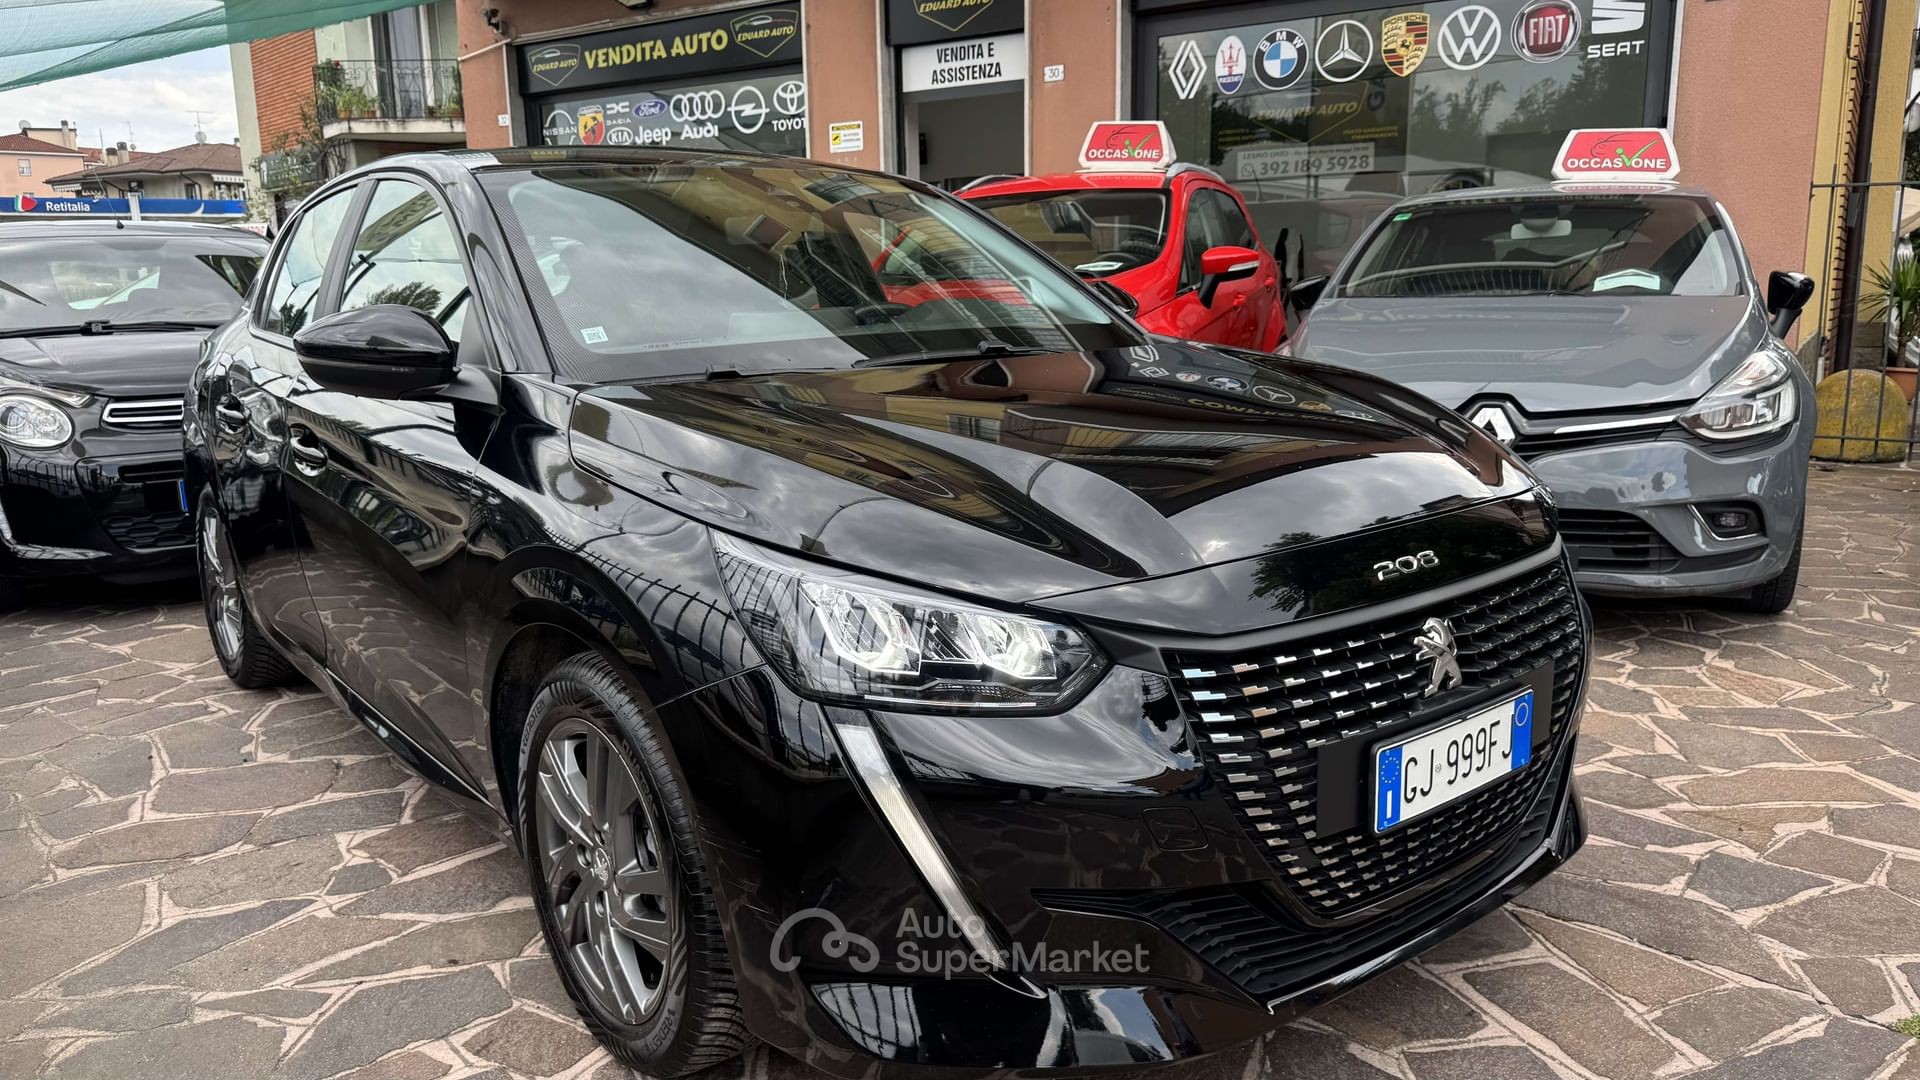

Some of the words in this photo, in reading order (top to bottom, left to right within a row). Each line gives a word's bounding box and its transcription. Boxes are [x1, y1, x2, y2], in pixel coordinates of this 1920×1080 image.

[919, 0, 959, 13] EDUARD
[737, 29, 770, 42] EDUARD
[770, 25, 794, 36] AUTO
[1528, 13, 1567, 46] FIAT
[584, 39, 667, 70] VENDITA
[670, 28, 729, 57] AUTO
[1259, 31, 1304, 52] BMW
[1587, 40, 1645, 59] SEAT
[936, 43, 984, 64] VENDITA
[987, 42, 995, 58] E
[931, 62, 1002, 85] ASSISTENZA
[1048, 68, 1060, 79] 30
[638, 103, 661, 117] Ford
[1317, 102, 1360, 117] AUTO
[543, 126, 577, 137] NISSAN
[606, 118, 632, 127] DACIA
[680, 122, 719, 141] Audi
[771, 118, 806, 132] TOYOT
[611, 131, 629, 142] KIA
[635, 126, 672, 146] Jeep
[1259, 162, 1290, 176] 392
[1293, 158, 1323, 173] 189
[1325, 154, 1370, 172] 5928
[46, 201, 91, 213] Retitalia
[1372, 550, 1440, 581] 208
